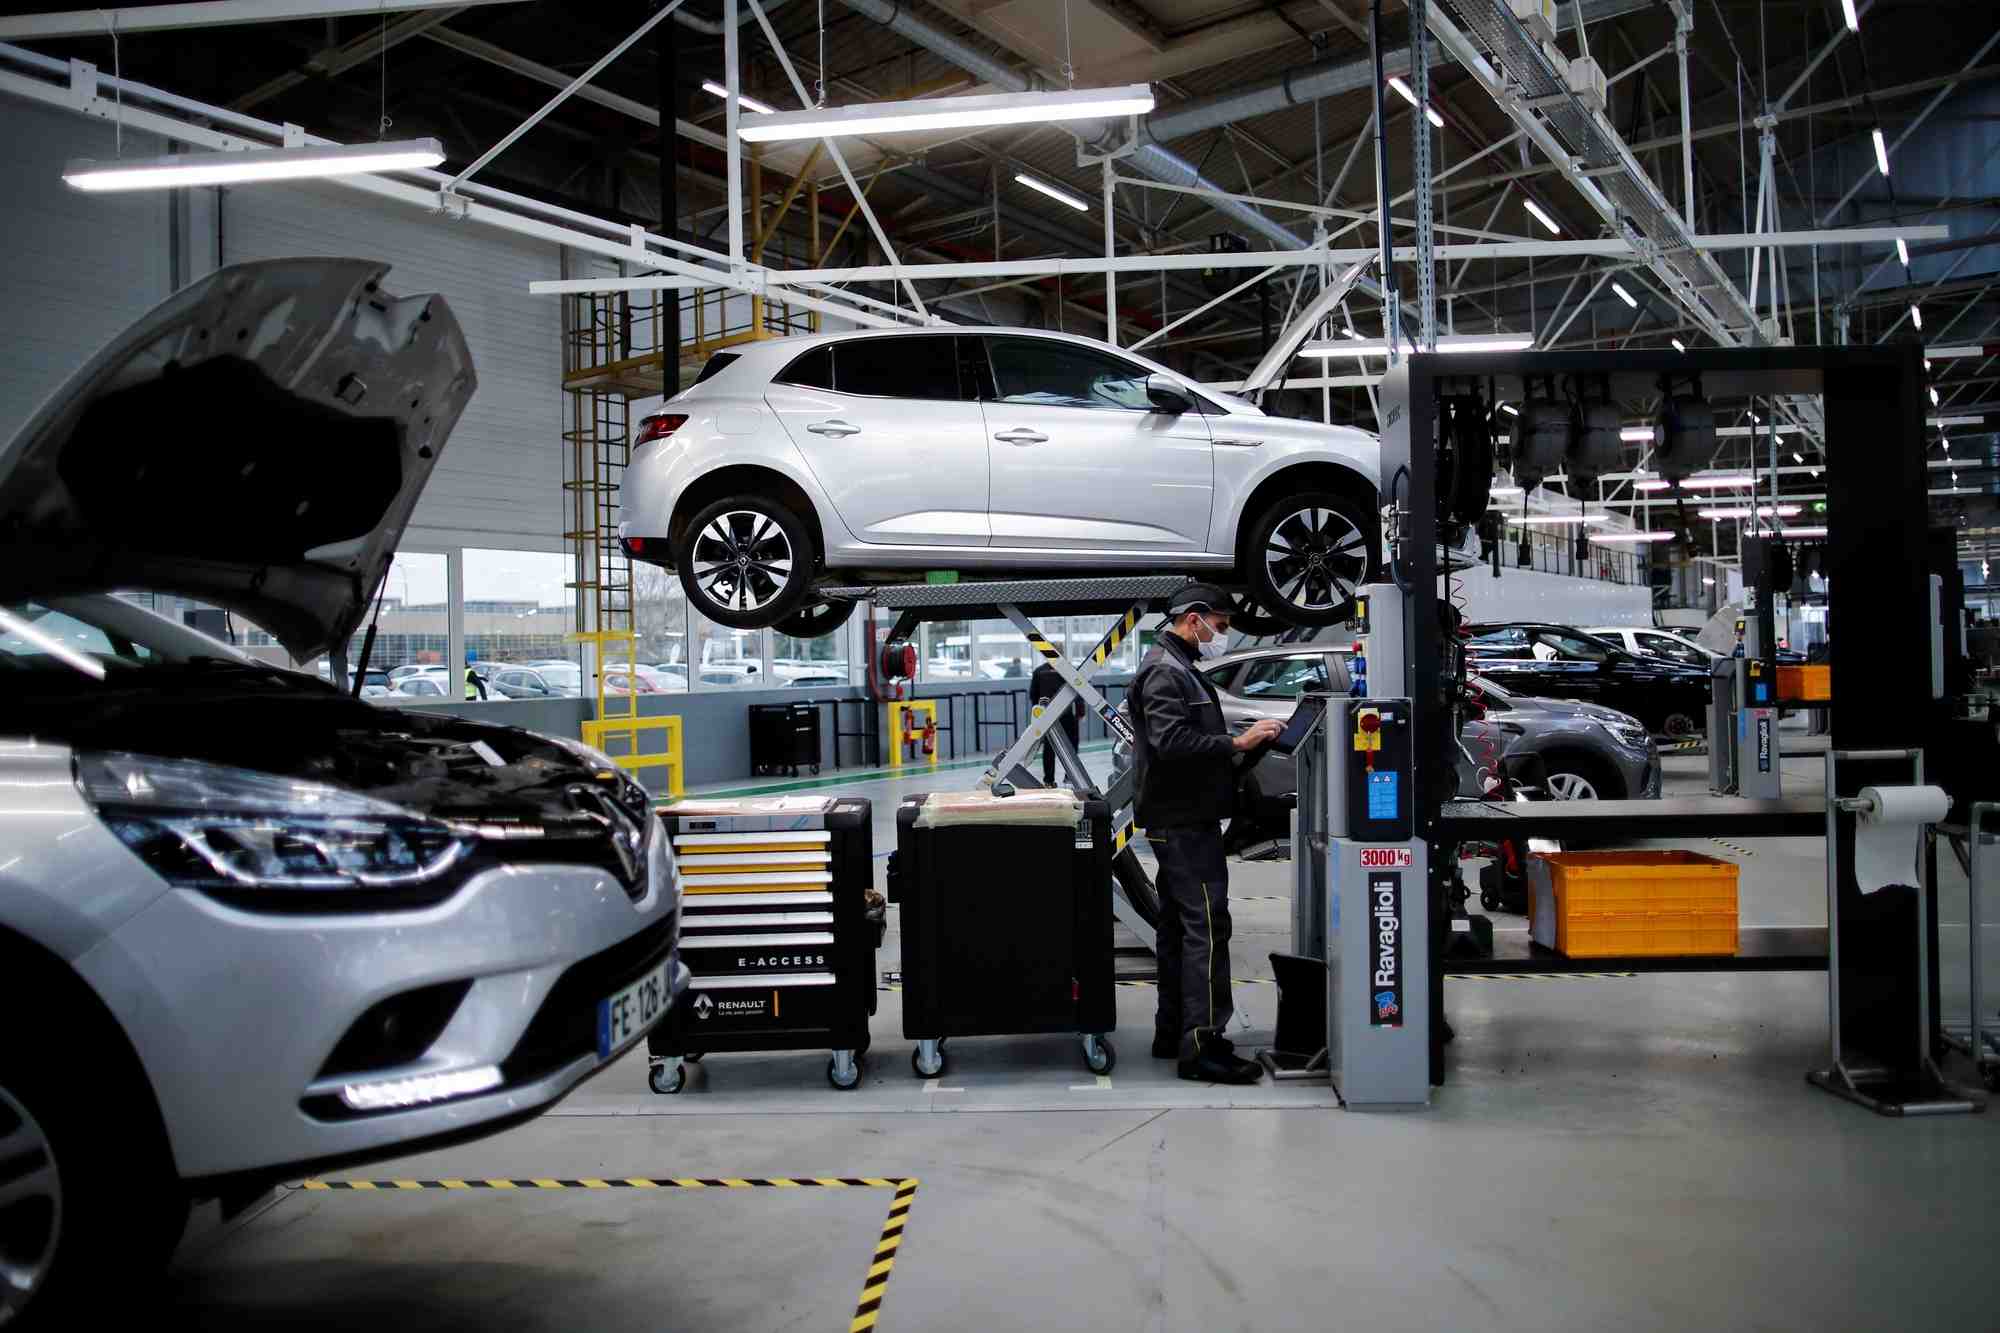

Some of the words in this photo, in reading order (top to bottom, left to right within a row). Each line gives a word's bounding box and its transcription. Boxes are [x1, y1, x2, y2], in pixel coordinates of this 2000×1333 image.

[1361, 849, 1396, 866] 3000
[1398, 849, 1410, 866] kg
[1374, 881, 1399, 986] Ravaglioli
[718, 1000, 766, 1009] RENAULT
